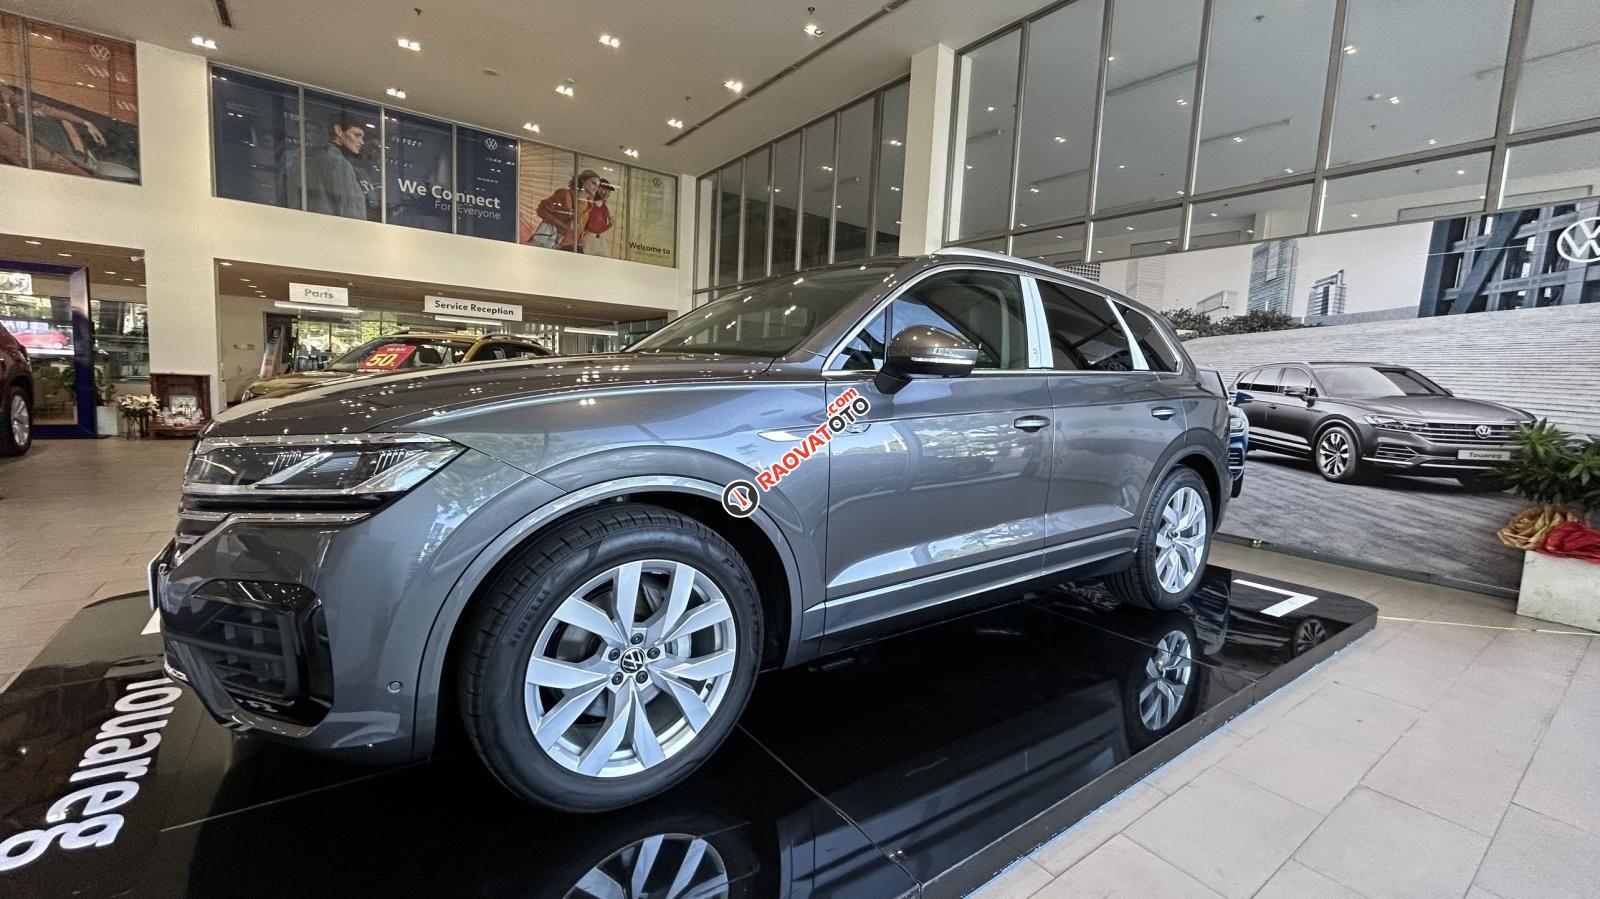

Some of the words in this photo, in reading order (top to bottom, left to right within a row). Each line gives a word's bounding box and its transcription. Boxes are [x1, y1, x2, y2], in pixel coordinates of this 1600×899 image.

[397, 178, 427, 196] We
[431, 185, 501, 209] Connect
[434, 200, 452, 211] For
[457, 204, 501, 220] Everyone
[628, 241, 662, 253] Welcome
[304, 288, 335, 299] Parts
[434, 300, 468, 311] Service
[470, 303, 514, 316] Reception
